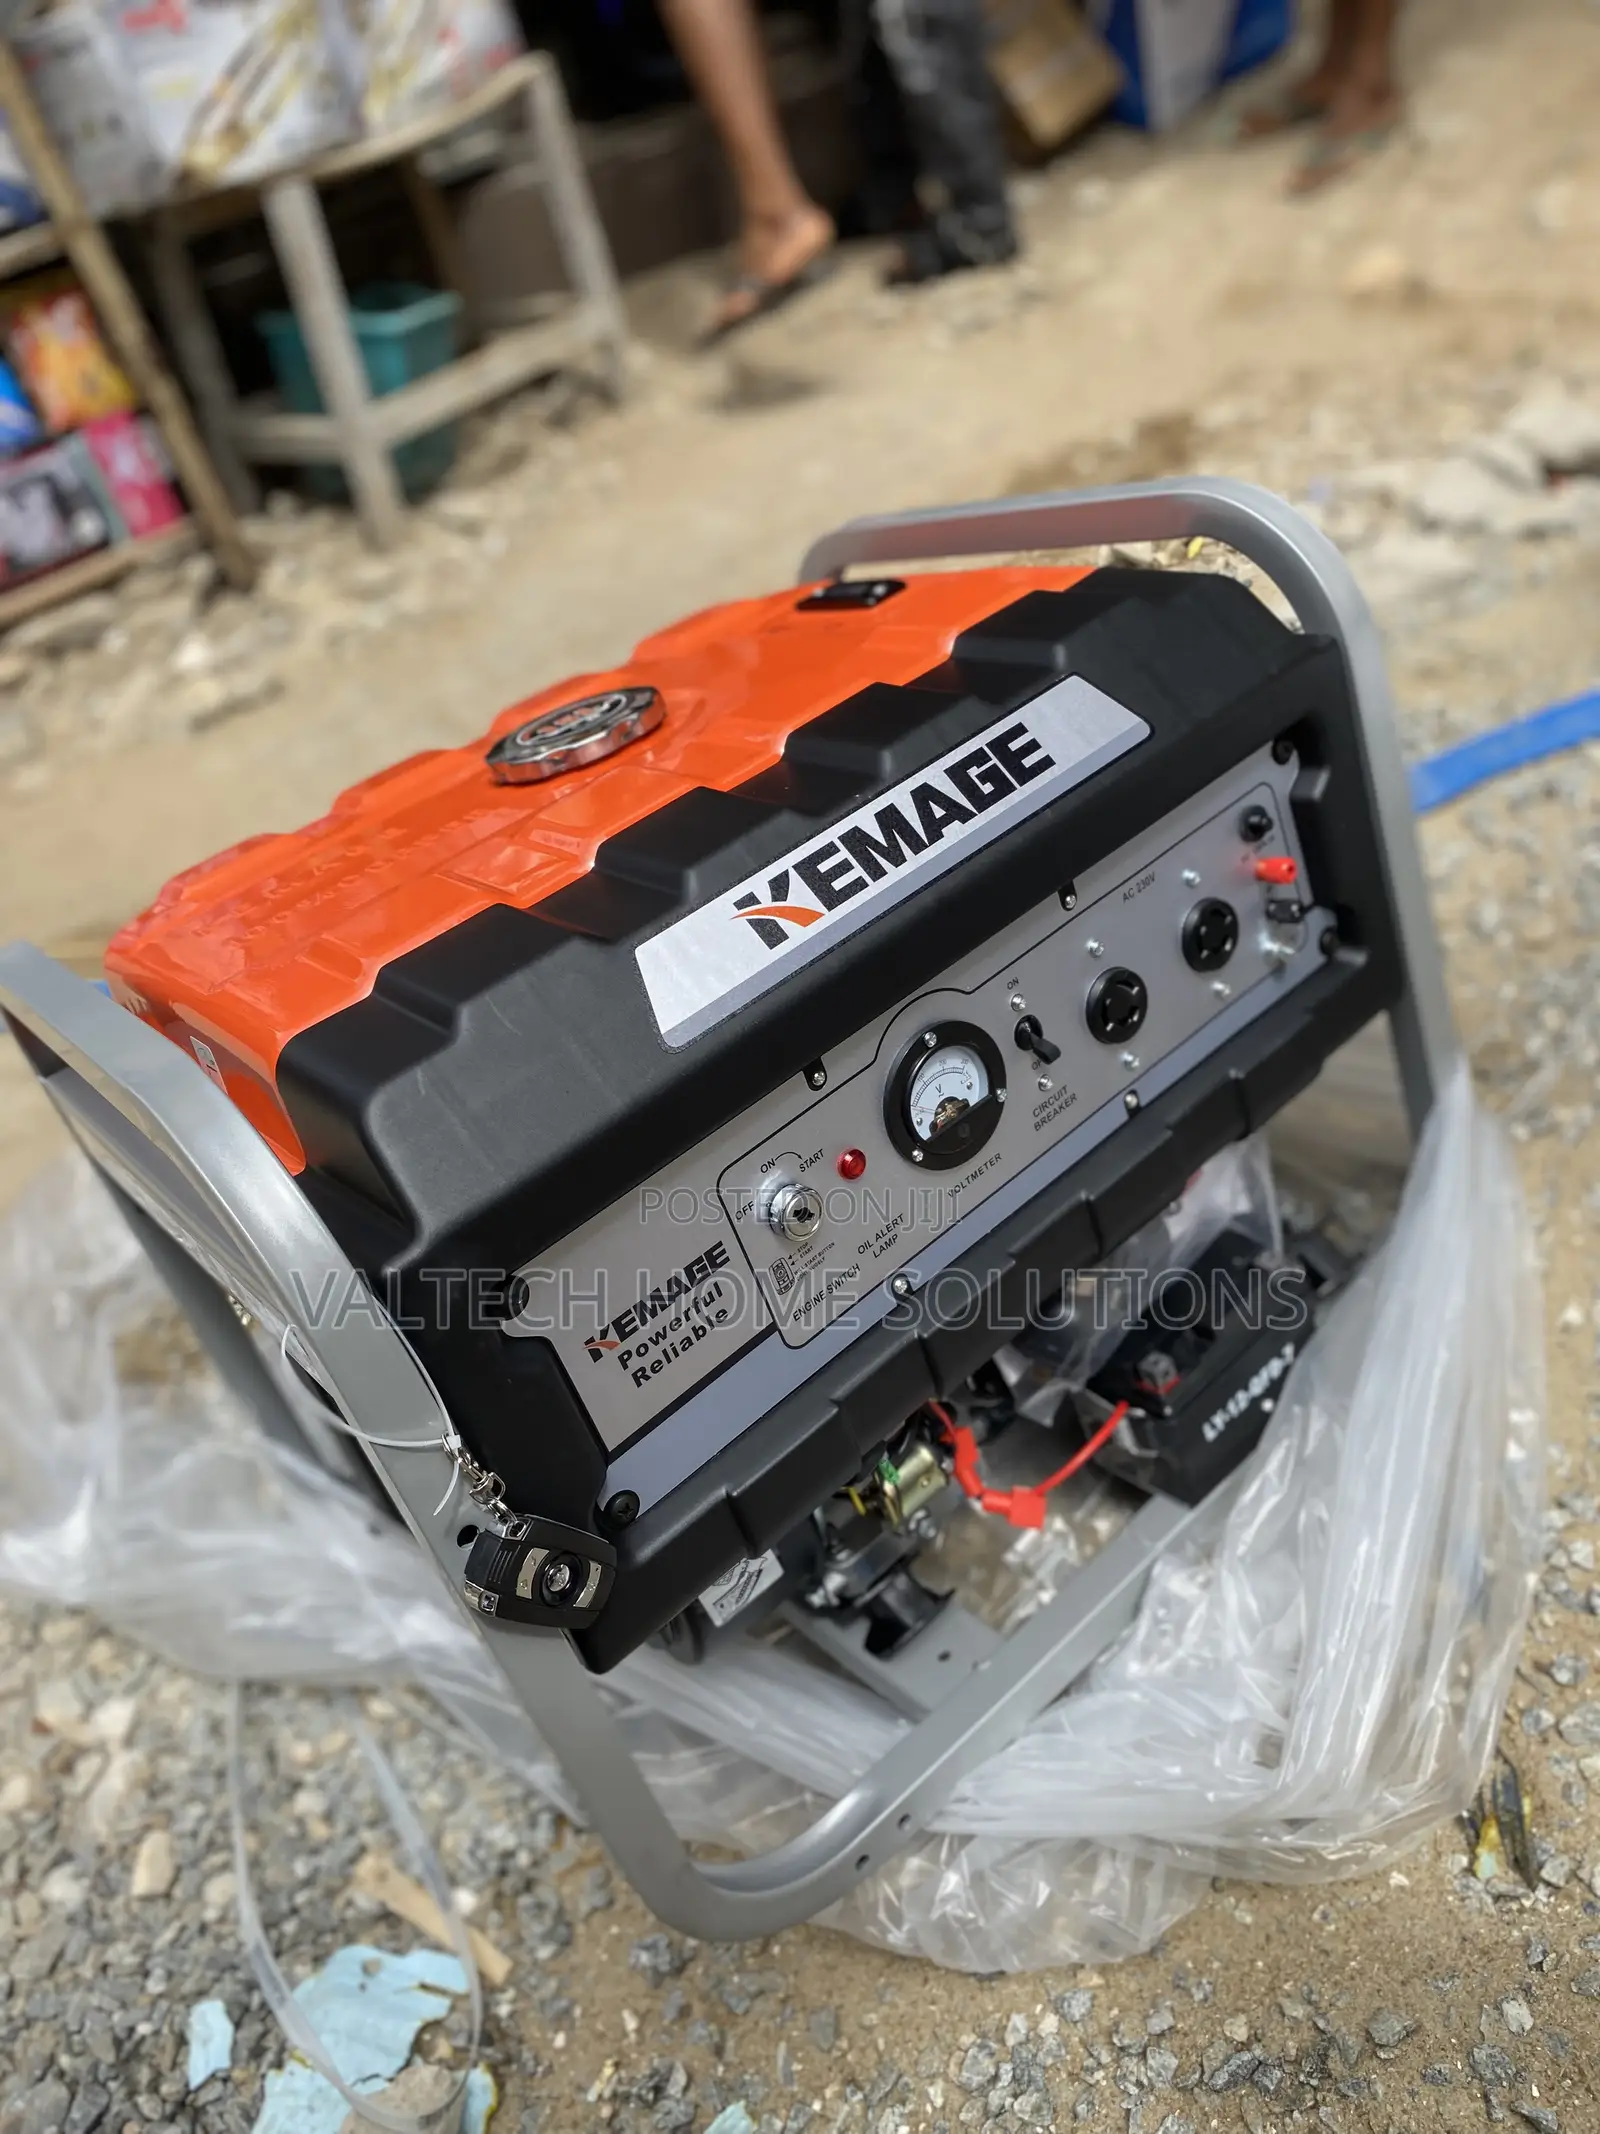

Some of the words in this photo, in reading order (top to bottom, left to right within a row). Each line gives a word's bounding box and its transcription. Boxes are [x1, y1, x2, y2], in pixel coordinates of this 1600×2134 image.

[731, 721, 1056, 950] KEMAGE
[1122, 887, 1135, 904] AC
[1006, 976, 1020, 991] ON
[1032, 1084, 1068, 1118] CIRCUIT
[1033, 1093, 1078, 1132] BREAKER
[760, 1158, 776, 1174] ON
[799, 1148, 825, 1173] START
[947, 1152, 1003, 1199] VOLTMETER
[735, 1201, 755, 1221] OFF
[799, 1245, 814, 1259] START
[857, 1237, 874, 1255] OIL
[875, 1213, 905, 1243] ALERT
[872, 1234, 899, 1259] LAMP
[582, 1240, 731, 1363] KEMAGE
[793, 1289, 826, 1322] ENGINE
[826, 1263, 861, 1296] SWITCH
[617, 1281, 723, 1371] Powerful
[630, 1308, 729, 1389] Reliable
